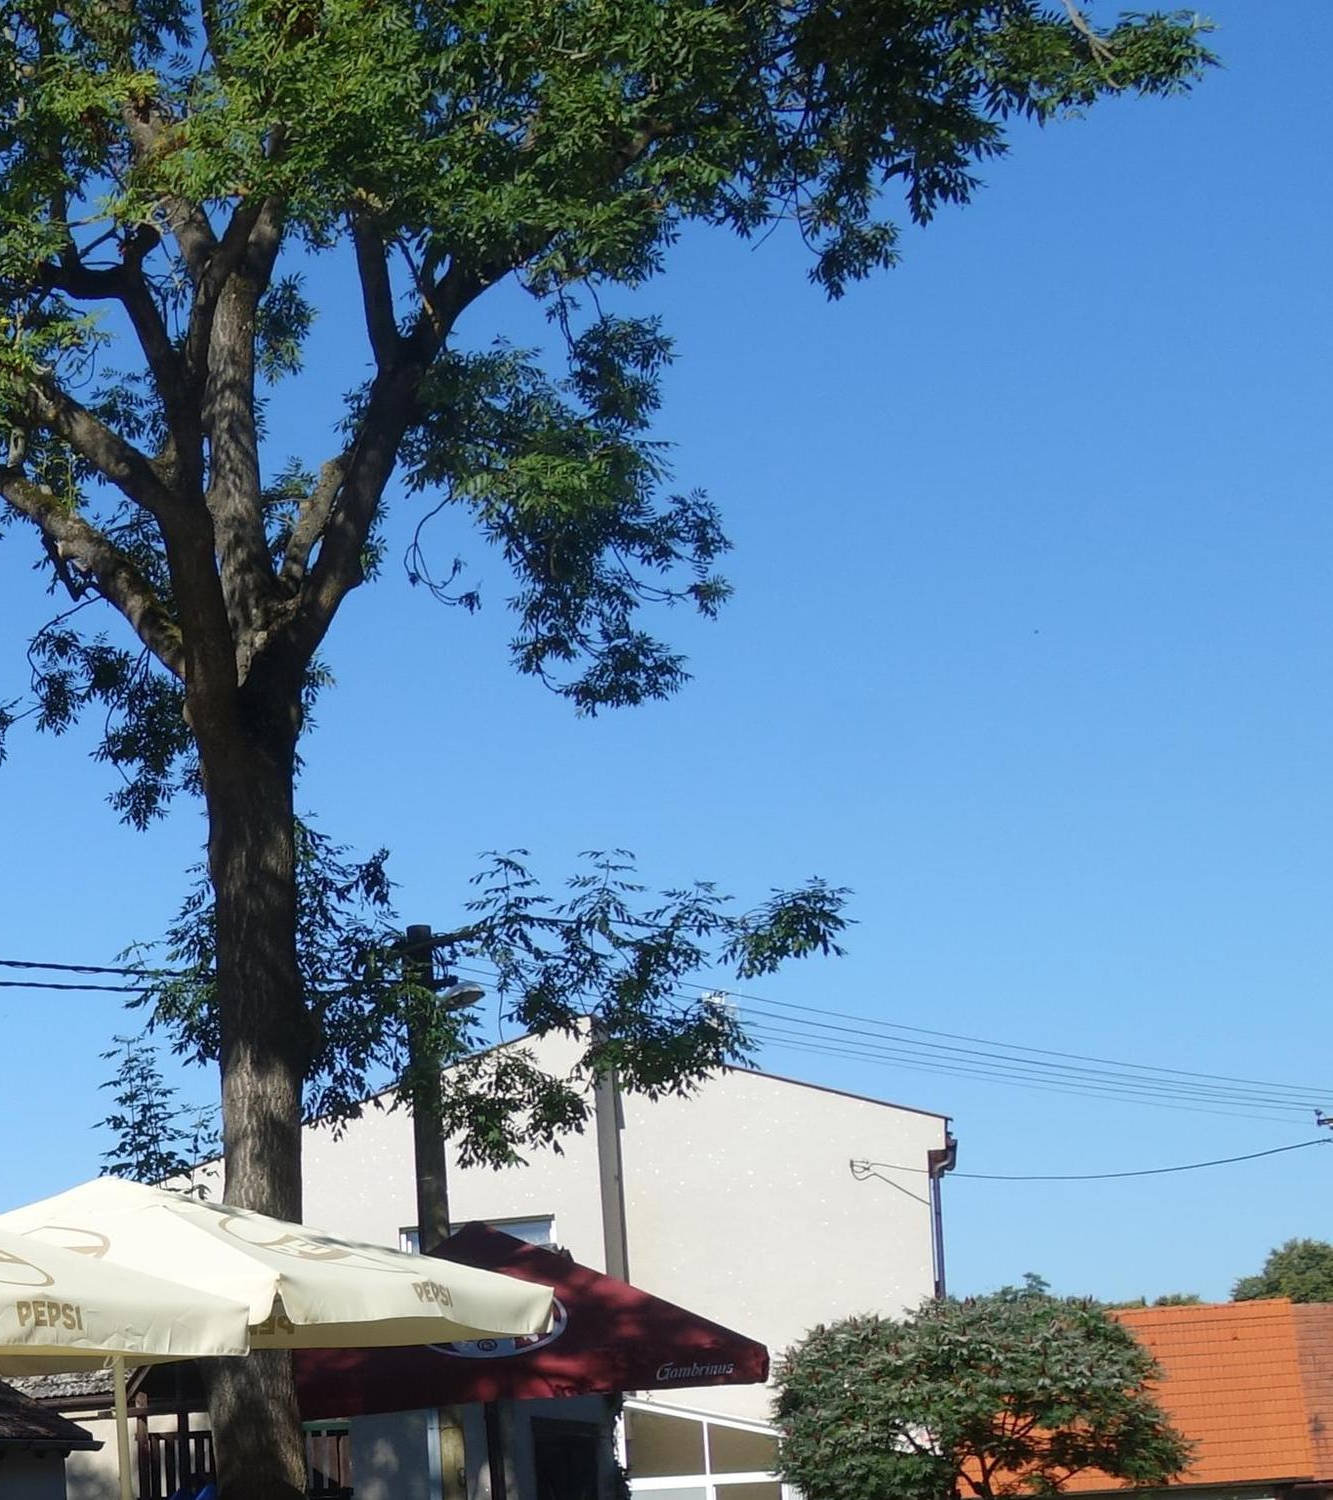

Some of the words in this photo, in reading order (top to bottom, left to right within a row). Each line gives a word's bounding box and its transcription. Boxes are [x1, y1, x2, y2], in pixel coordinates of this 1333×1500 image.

[412, 1281, 455, 1308] PEPSI
[15, 1300, 84, 1331] PEPSI
[656, 1361, 735, 1381] Gambrinus
